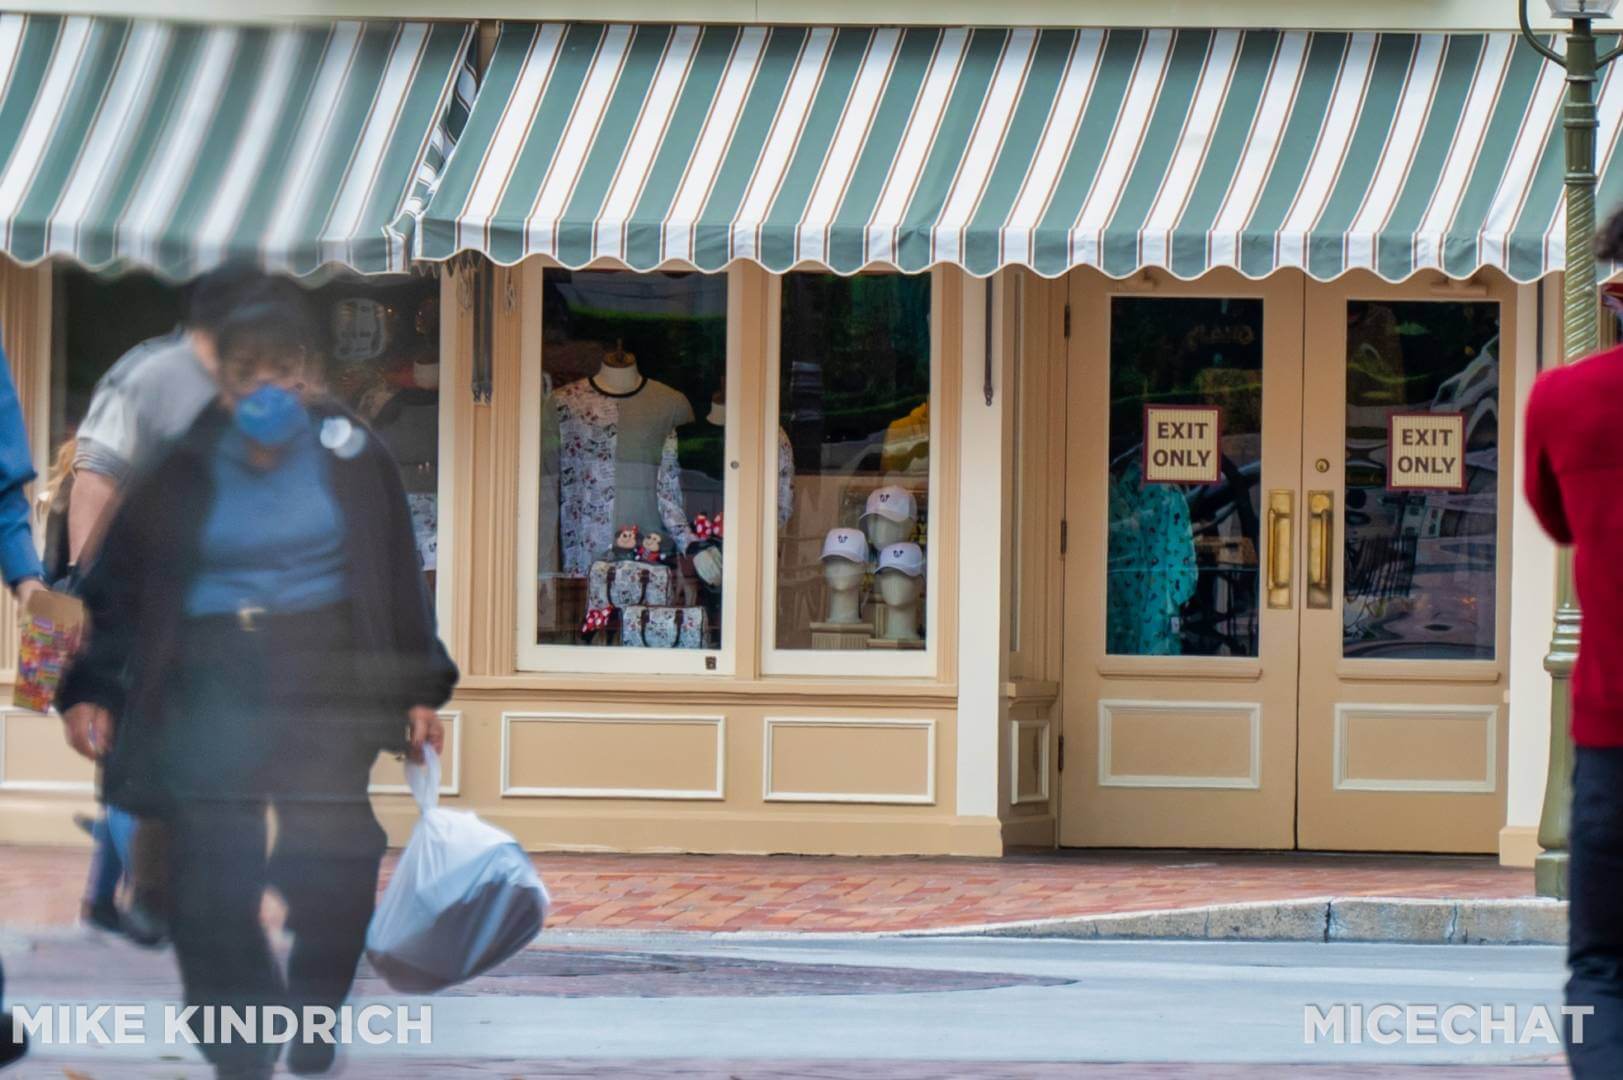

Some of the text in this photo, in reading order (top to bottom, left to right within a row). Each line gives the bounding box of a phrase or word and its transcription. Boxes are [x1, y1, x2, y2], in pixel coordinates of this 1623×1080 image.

[1157, 422, 1209, 440] EXIT
[1401, 428, 1453, 447] EXIT
[1153, 449, 1211, 468] ONLY
[1397, 455, 1456, 474] ONLY
